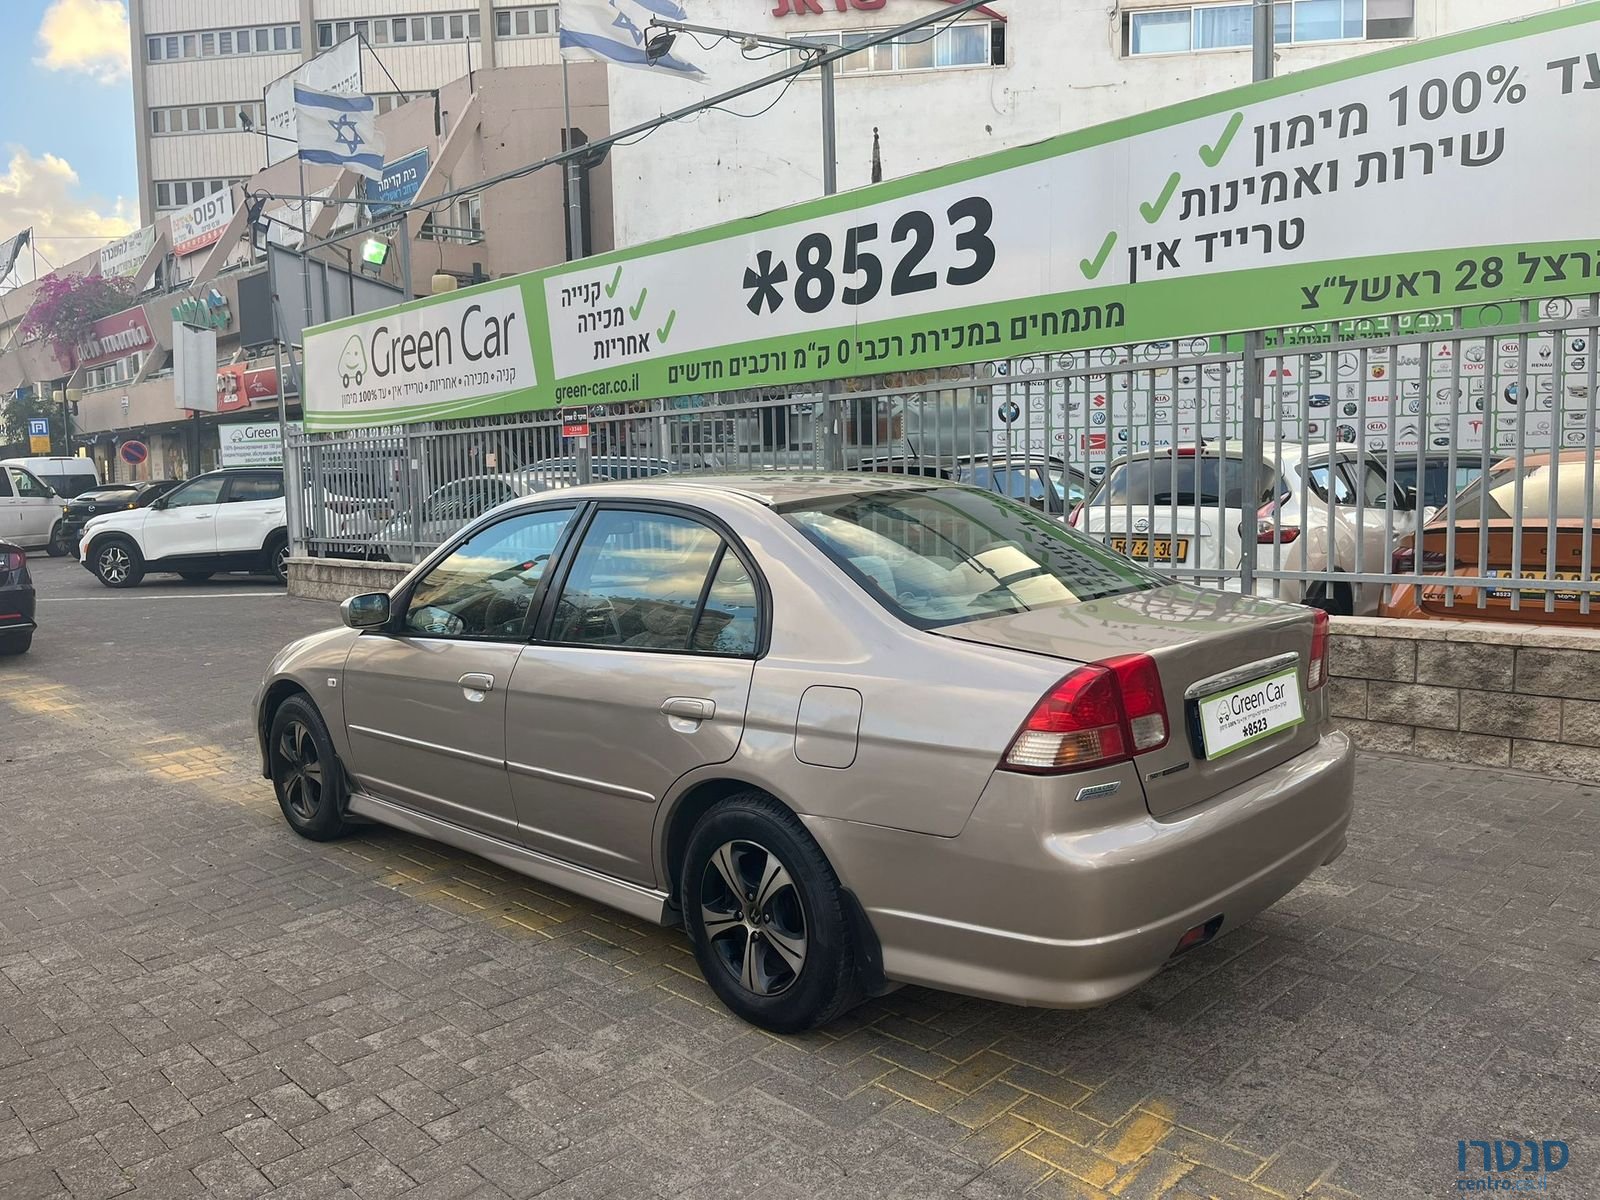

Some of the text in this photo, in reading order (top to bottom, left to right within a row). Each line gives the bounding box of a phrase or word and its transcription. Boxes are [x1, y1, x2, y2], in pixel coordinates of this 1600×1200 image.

[1389, 64, 1527, 127] 100%
[1253, 101, 1368, 167] מימון
[378, 168, 417, 192] בית קדימה
[1179, 126, 1505, 221] שירות ואמינות
[194, 196, 225, 225] דפוס
[1128, 217, 1305, 285] טרייד אין
[1455, 257, 1503, 292] 28
[1518, 250, 1600, 286] רצל
[562, 281, 601, 308] קנייה
[578, 307, 625, 333] מכירה
[1010, 302, 1125, 341] מתמחים
[101, 320, 150, 354] mania
[371, 304, 515, 378] Green Car
[593, 332, 651, 360] אחריות
[838, 338, 850, 364] 0
[856, 336, 902, 361] רכבי
[910, 320, 1000, 355] במכירת
[464, 371, 489, 387] מכירה
[668, 362, 724, 384] חדשים
[729, 353, 786, 377] ורכבים
[359, 389, 377, 403] 100%
[429, 376, 457, 391] אחריות
[555, 373, 639, 404] green-car.co.il
[245, 427, 278, 439] Green
[1231, 691, 1265, 716] Green
[1266, 682, 1285, 703] Car
